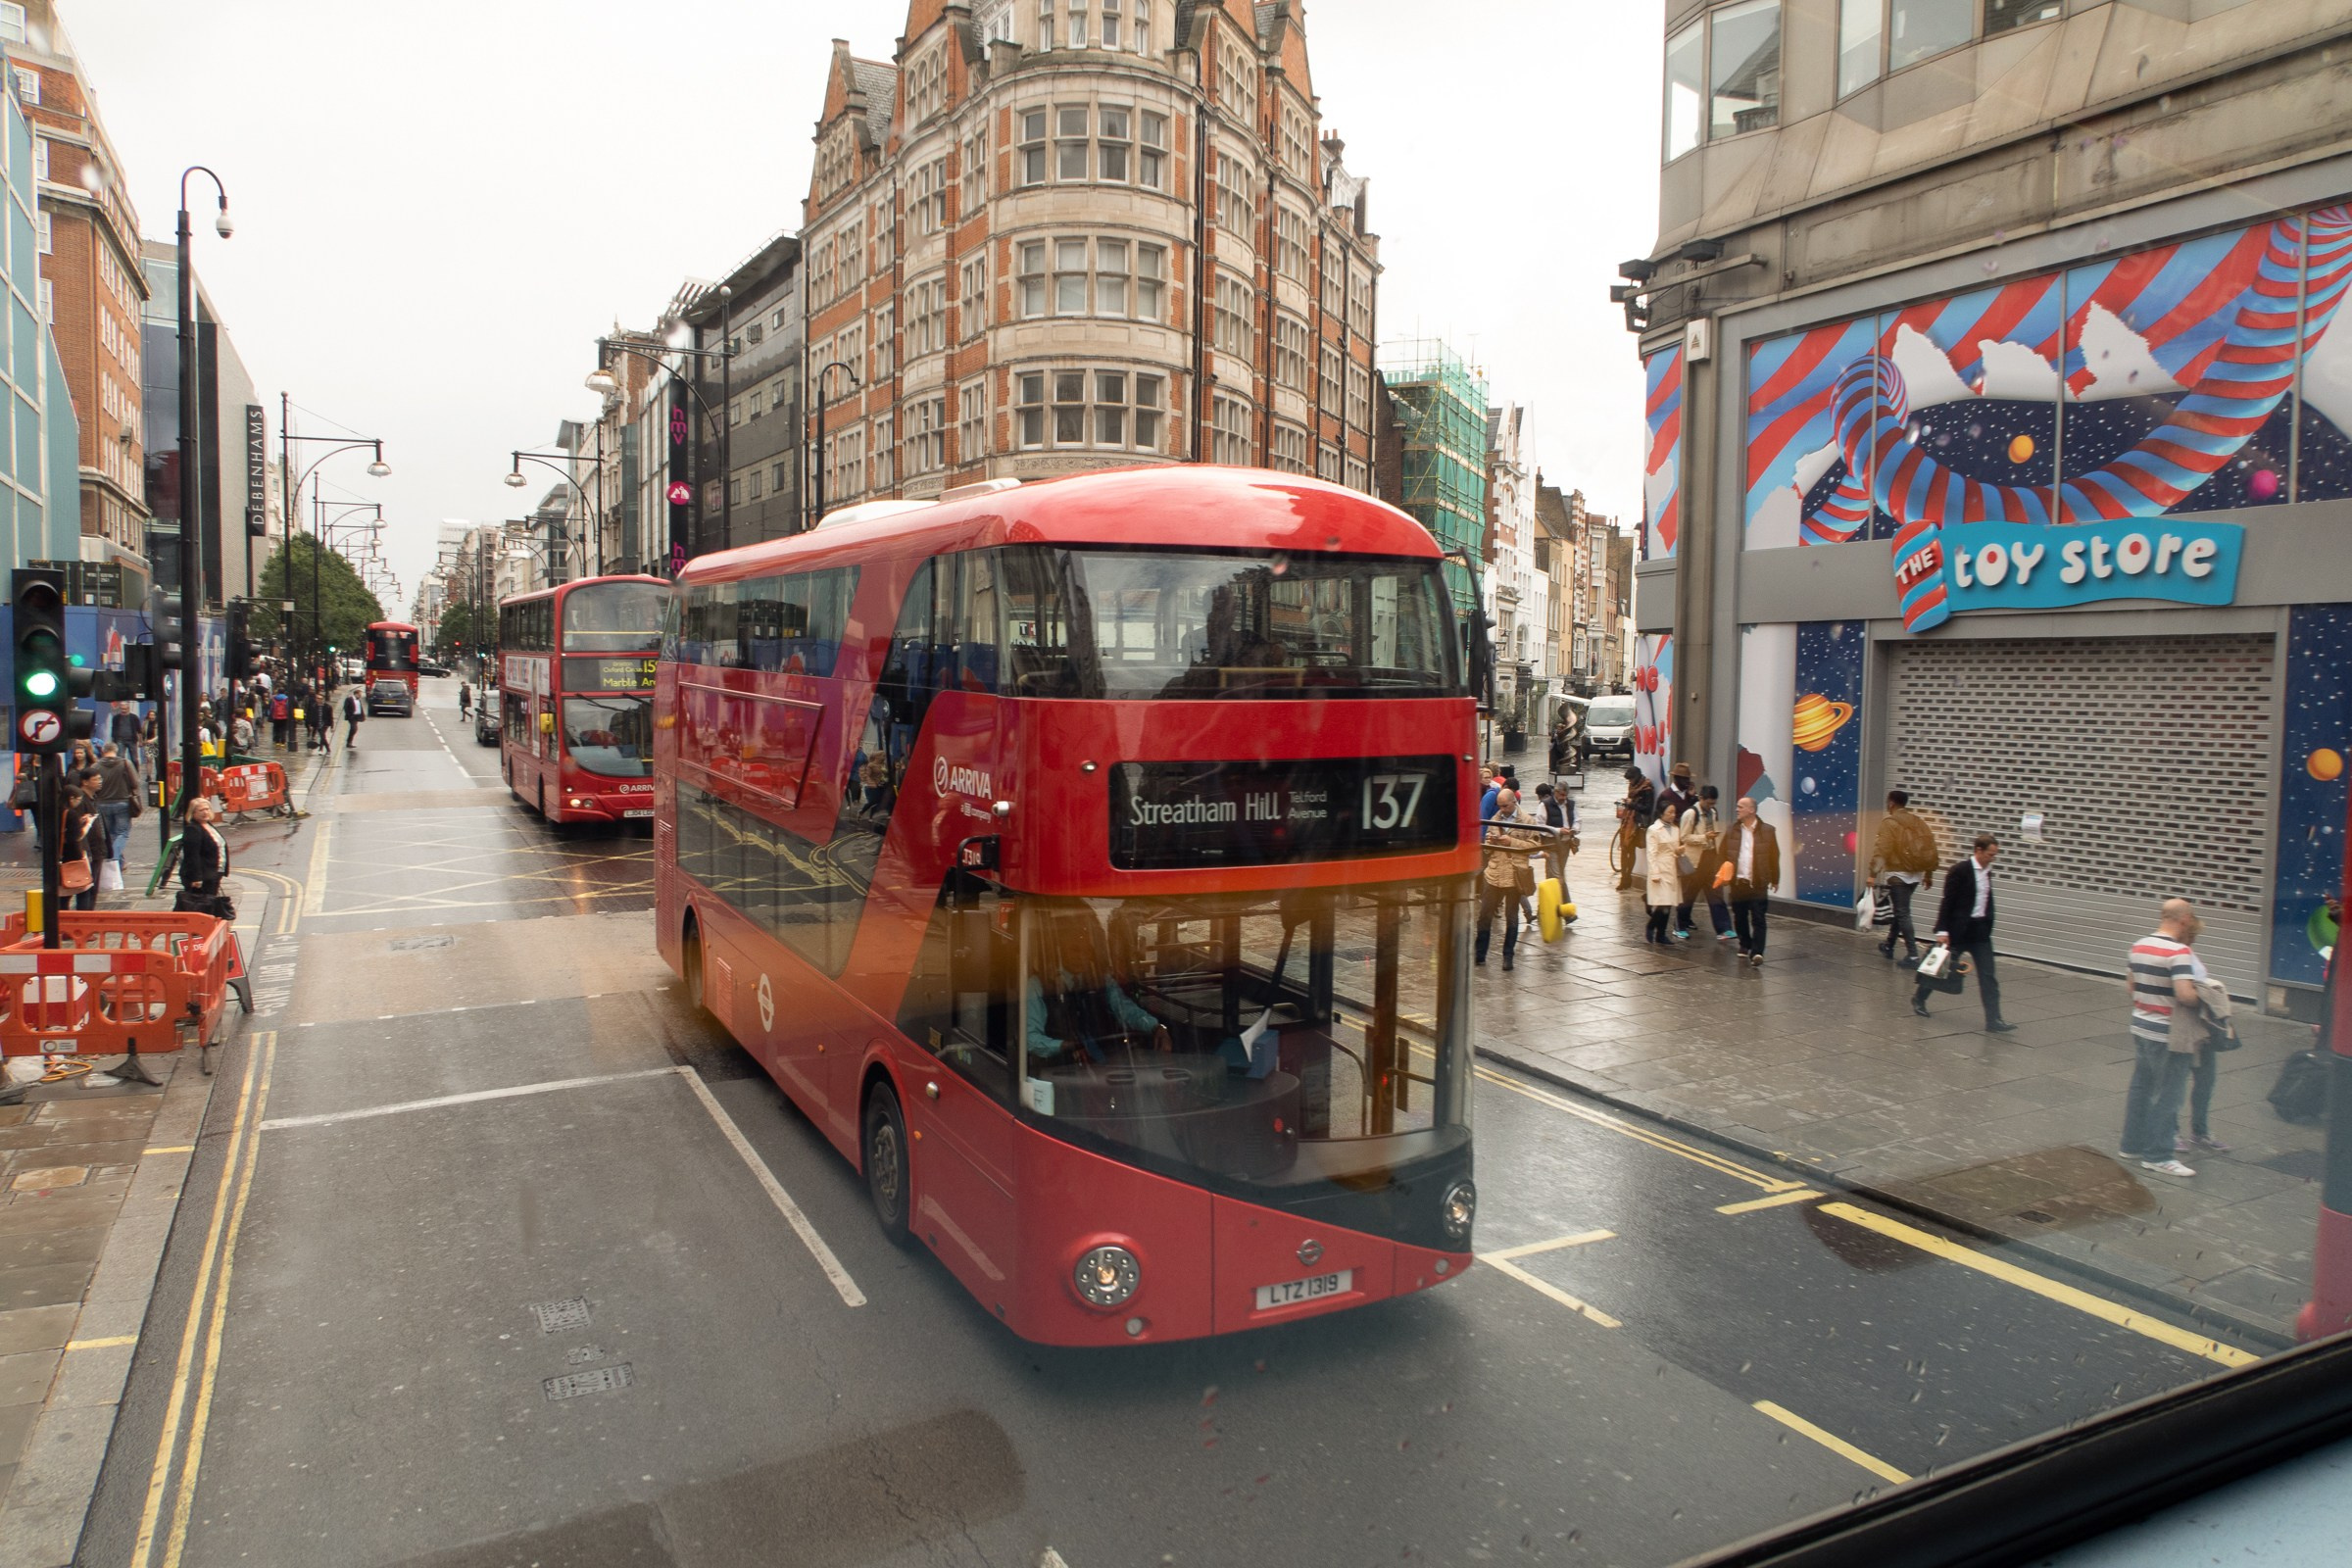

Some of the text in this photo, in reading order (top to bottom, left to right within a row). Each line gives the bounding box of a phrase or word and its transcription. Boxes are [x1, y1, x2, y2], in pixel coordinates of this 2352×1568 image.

[670, 404, 688, 446] hmv
[250, 411, 265, 525] DEBENHAMS
[1894, 547, 1937, 585] THE
[603, 677, 638, 687] Marble
[644, 661, 659, 673] 15
[950, 766, 993, 800] ARRIVA
[1287, 790, 1328, 804] Telford
[1130, 792, 1282, 826] Streatham Hill
[1287, 807, 1328, 819] Avenue
[1362, 773, 1428, 830] 137
[961, 848, 982, 865] T319
[1270, 1274, 1339, 1304] LTZ 1319
